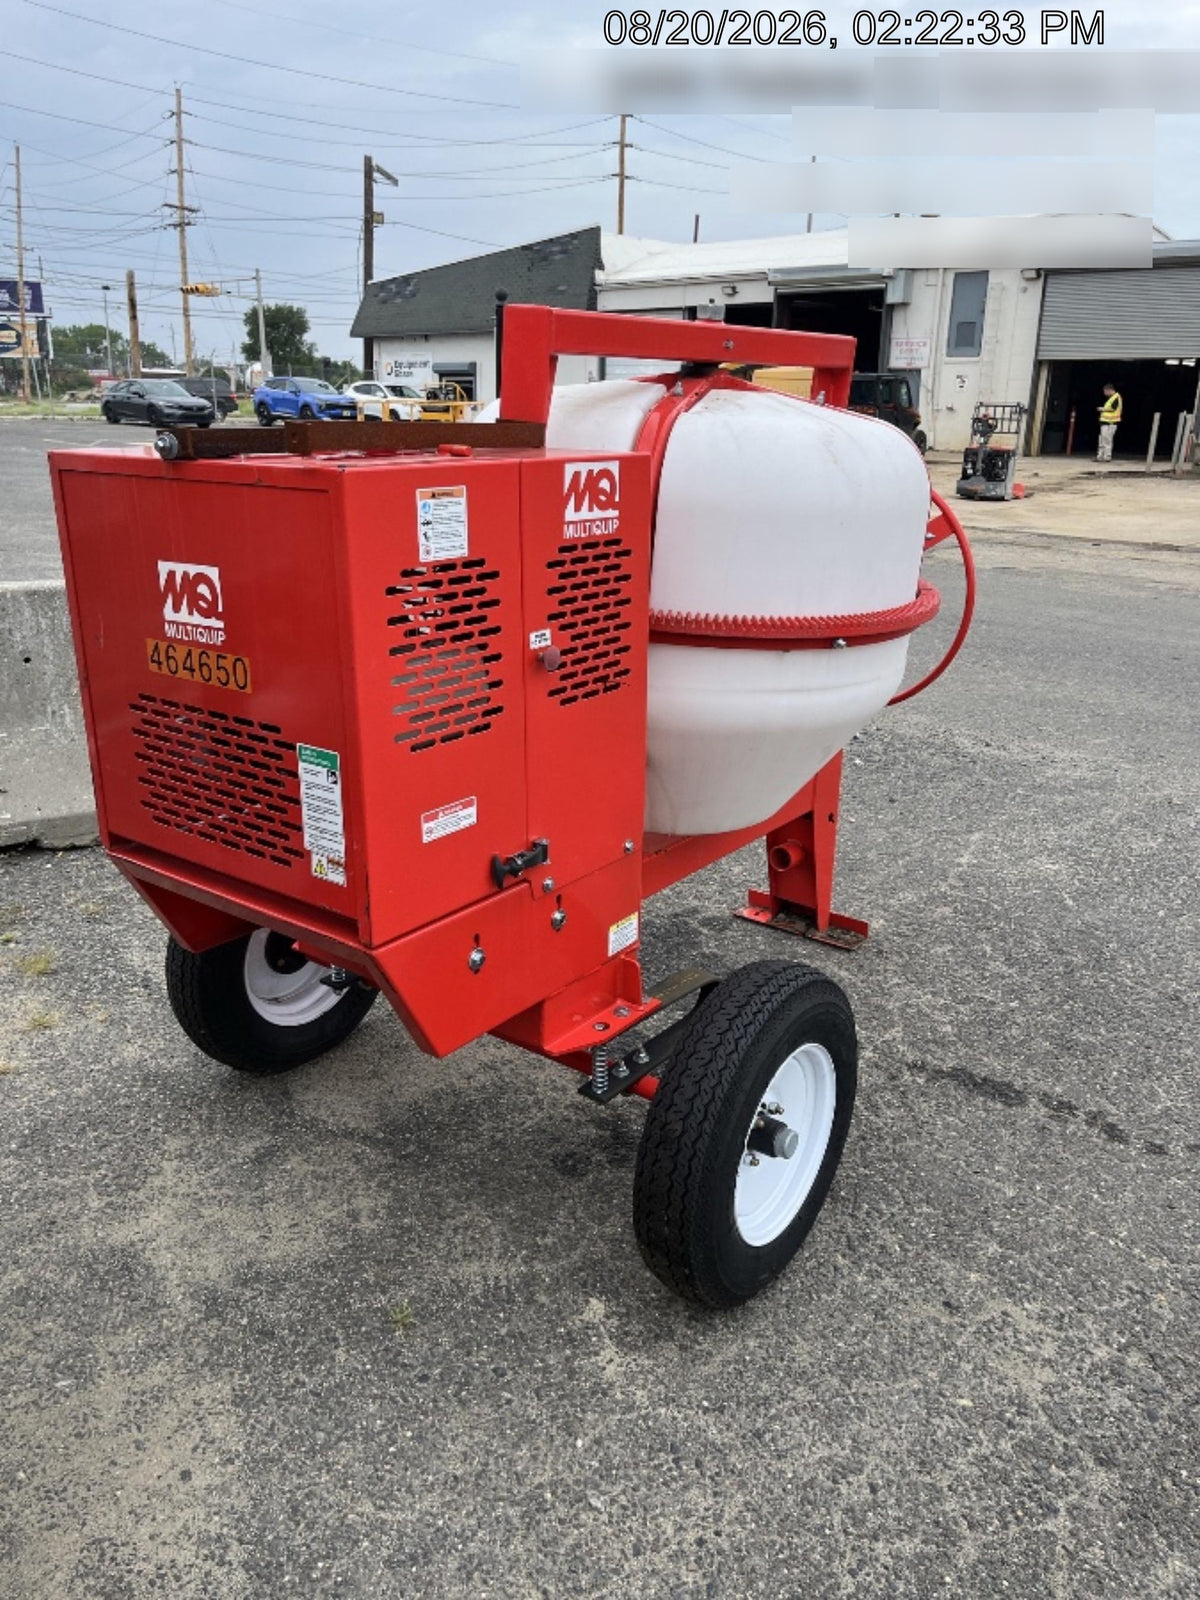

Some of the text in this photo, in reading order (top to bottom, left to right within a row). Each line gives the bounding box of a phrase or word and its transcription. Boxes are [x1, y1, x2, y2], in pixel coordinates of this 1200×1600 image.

[563, 464, 620, 516] MQ
[563, 518, 620, 539] MULTIQUIP
[158, 563, 224, 624] MQ
[163, 621, 226, 646] MULTIQUIP
[148, 640, 249, 690] 464650
